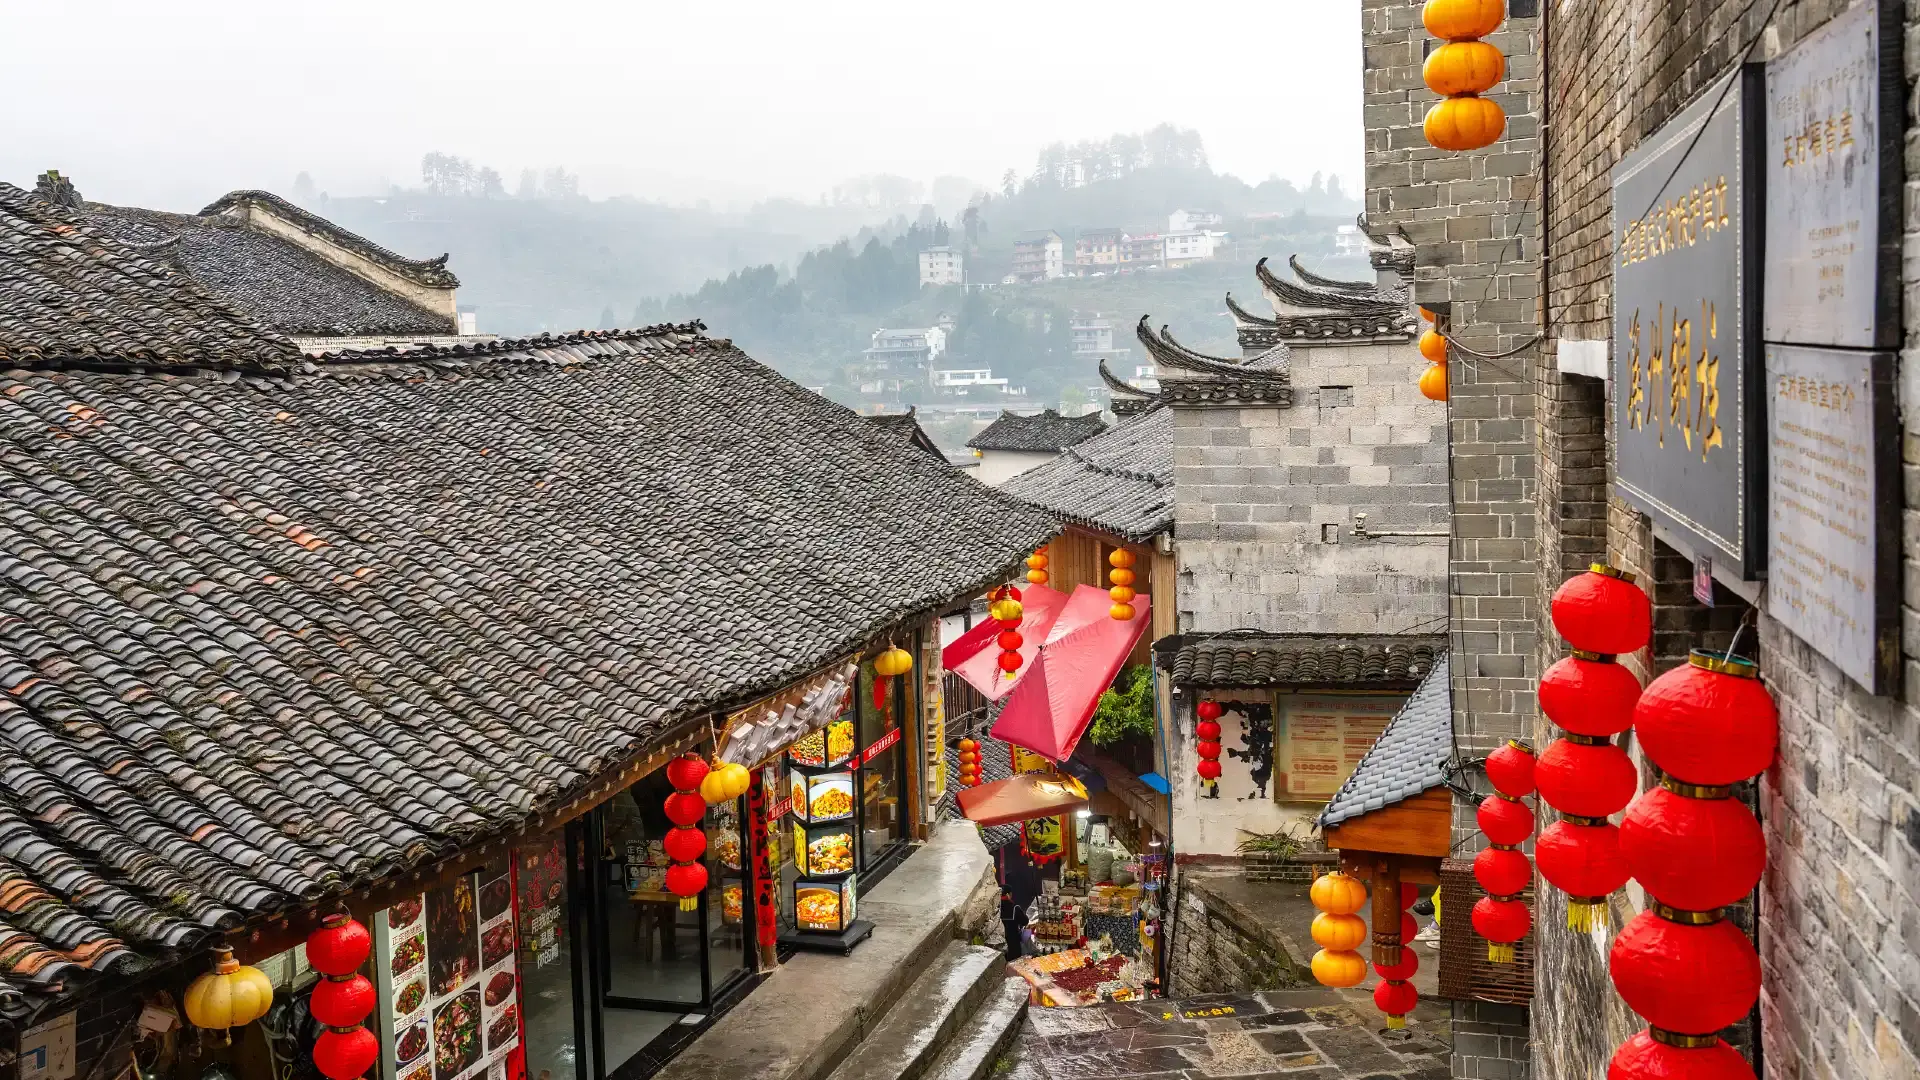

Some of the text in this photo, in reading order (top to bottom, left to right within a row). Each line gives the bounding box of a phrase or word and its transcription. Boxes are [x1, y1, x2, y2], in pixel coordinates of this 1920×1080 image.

[1621, 175, 1729, 268] 全国重点文物保护单位
